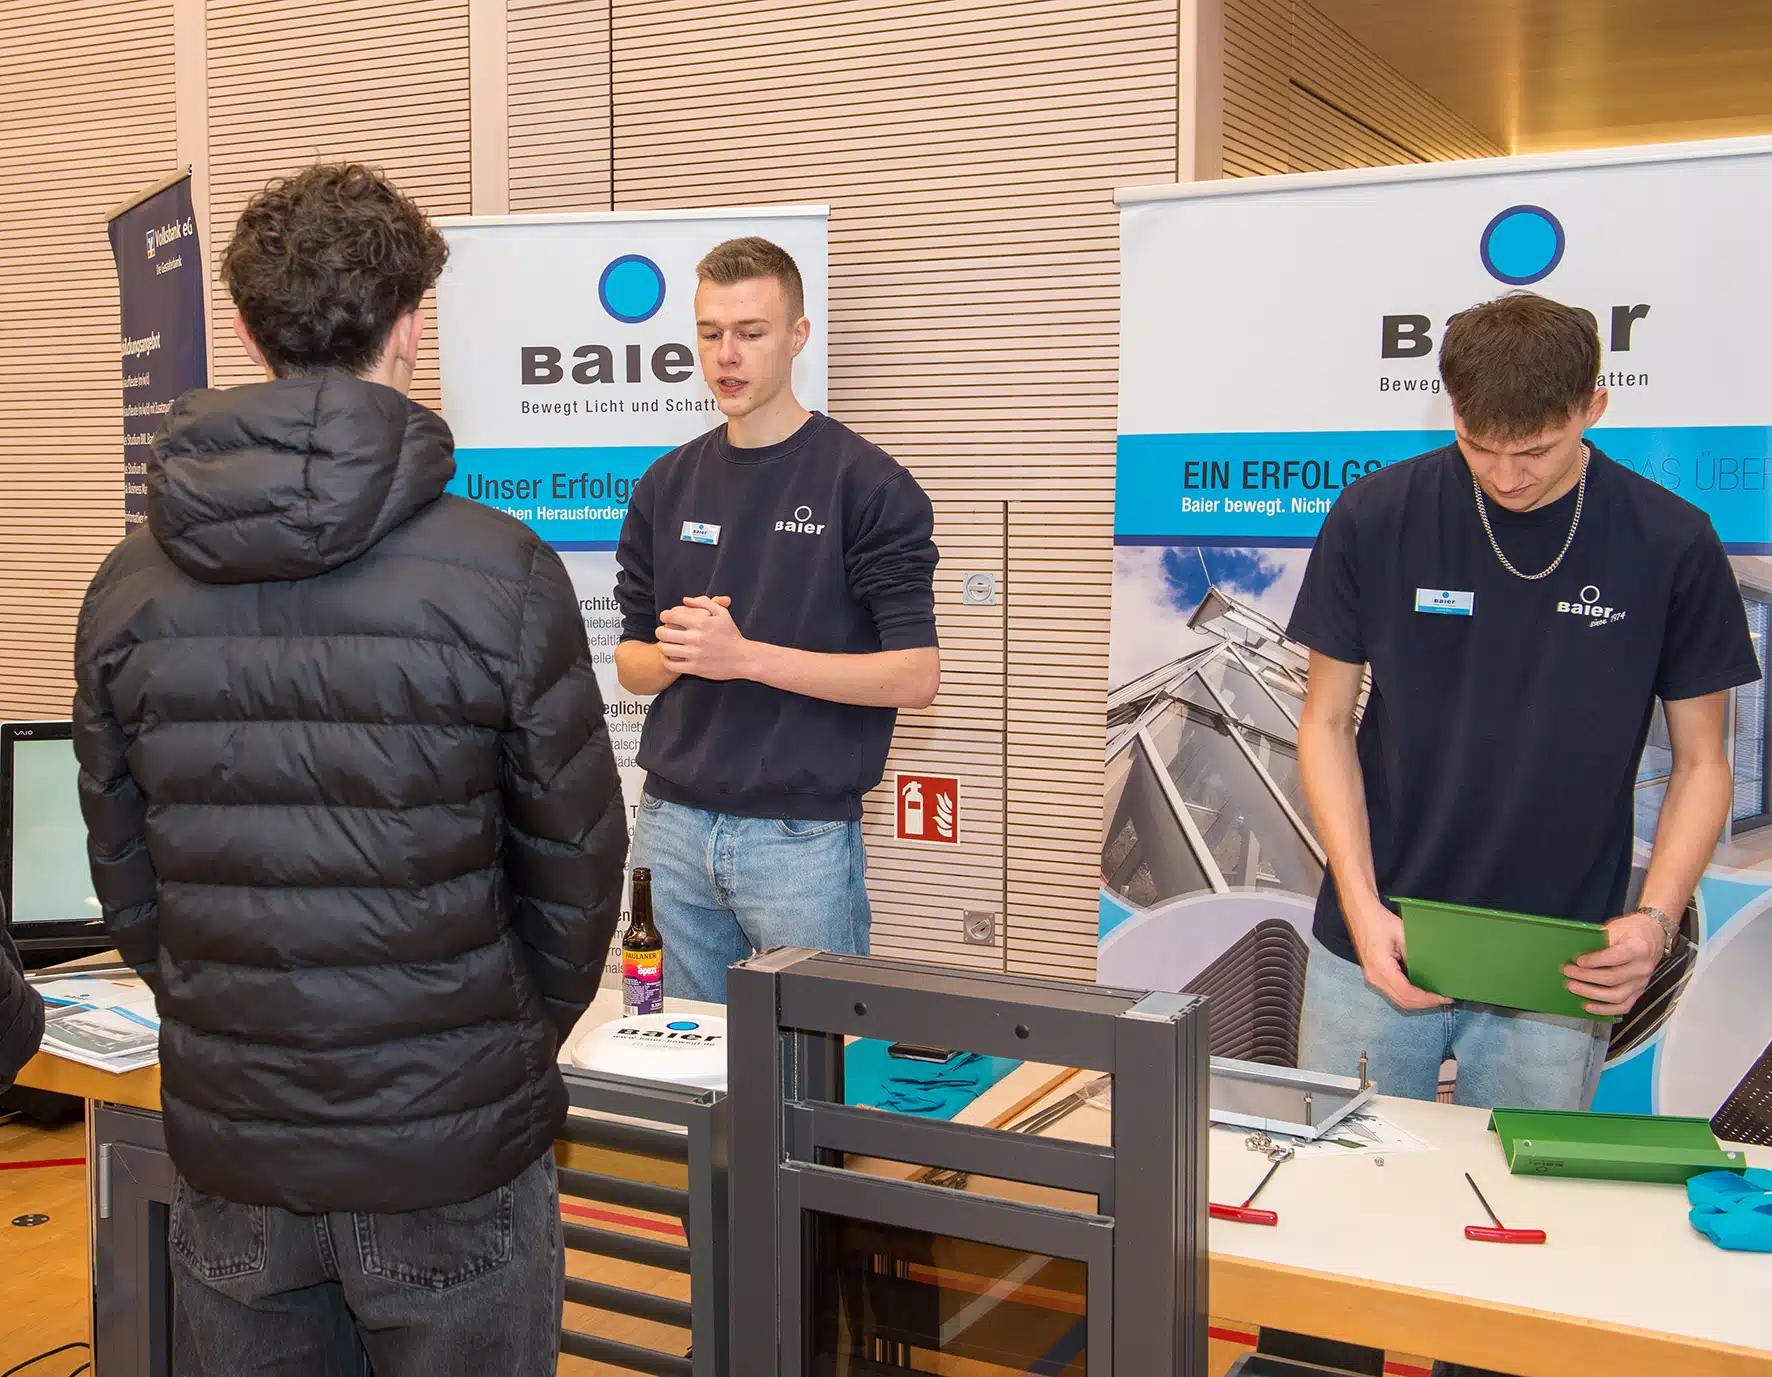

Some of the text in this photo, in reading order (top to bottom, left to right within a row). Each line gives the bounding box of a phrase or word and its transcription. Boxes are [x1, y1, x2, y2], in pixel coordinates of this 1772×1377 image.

[183, 216, 193, 237] eG
[521, 342, 695, 385] Baie
[1380, 372, 1649, 394] Beweg atten
[521, 398, 720, 416] Bewegt Licht und Schatt
[1184, 459, 1397, 490] EIN ERFOLGS
[467, 474, 542, 499] Unser
[537, 505, 629, 520] Herausforder
[1181, 497, 1331, 516] Baier bewegt. Nicht
[774, 520, 826, 535] Baier
[1556, 601, 1614, 618] Baier
[625, 952, 657, 960] PAULANER
[617, 1028, 722, 1042] Baier
